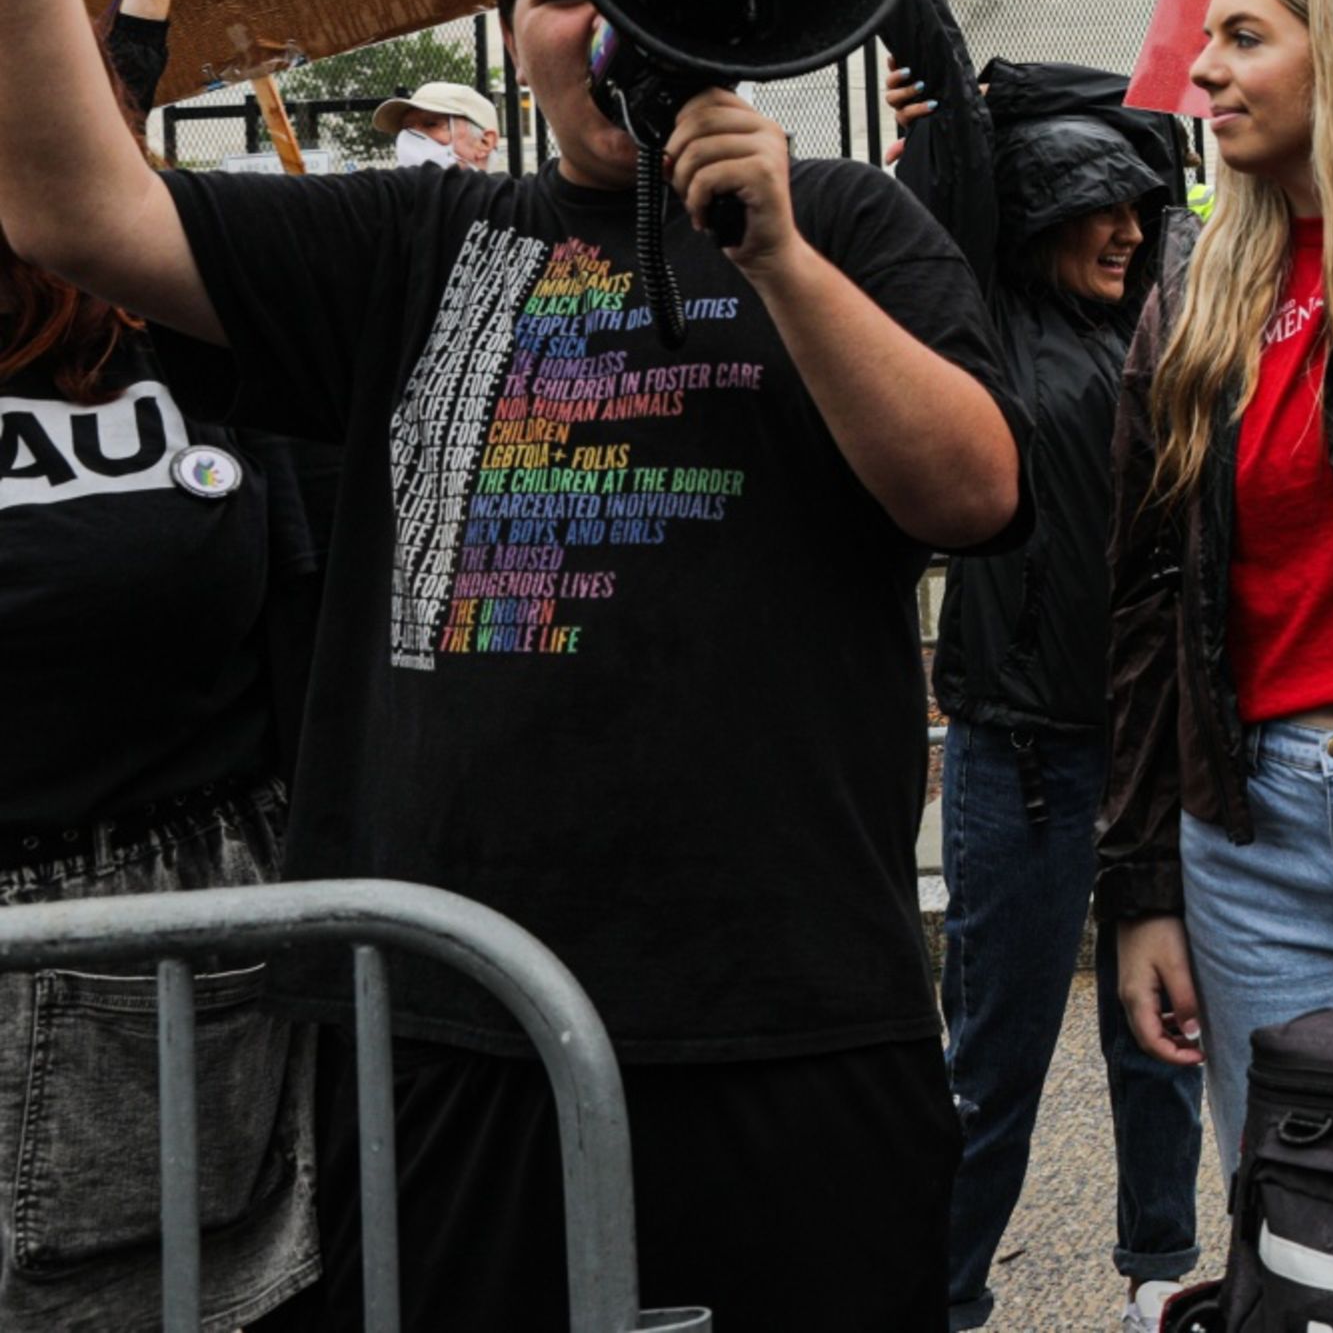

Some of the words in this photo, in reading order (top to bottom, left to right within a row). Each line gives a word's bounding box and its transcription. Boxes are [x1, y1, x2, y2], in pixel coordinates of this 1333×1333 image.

[524, 295, 579, 315] BLACK
[626, 298, 739, 330] DISLITIES
[546, 336, 588, 357] SICK
[539, 351, 628, 379] HOMELESS
[460, 373, 501, 396] FOR:
[532, 373, 617, 400] CHILDREN
[620, 372, 641, 395] IN
[644, 365, 711, 392] FOSTER
[716, 363, 764, 390] CARE
[453, 397, 492, 421] FOR:
[494, 394, 601, 422] NON-HUMAN
[601, 391, 685, 420] ANIMALS
[447, 422, 486, 445] FOR:
[487, 418, 571, 445] CHILDREN
[443, 447, 480, 470] FOR:
[571, 444, 631, 471] FOLKS
[441, 471, 473, 495] FOR:
[476, 469, 508, 494] THE
[511, 469, 599, 494] CHILDREN
[601, 469, 627, 494] AT
[632, 467, 672, 493] THE
[671, 468, 746, 496] BORDER
[470, 493, 600, 518] INCARCERATED
[606, 493, 727, 521] INDIVIDUALS
[566, 521, 605, 546] AND
[609, 520, 667, 545] GIRLS
[461, 546, 489, 570] THE
[493, 546, 565, 571] ABUSED
[453, 572, 558, 599] INDIGENOUS
[561, 572, 616, 599] LIVES
[448, 600, 478, 625] THE
[481, 599, 557, 625] UNBORN
[440, 627, 473, 653] THE
[477, 627, 538, 653] WHOLE
[540, 627, 581, 653] LIFE
